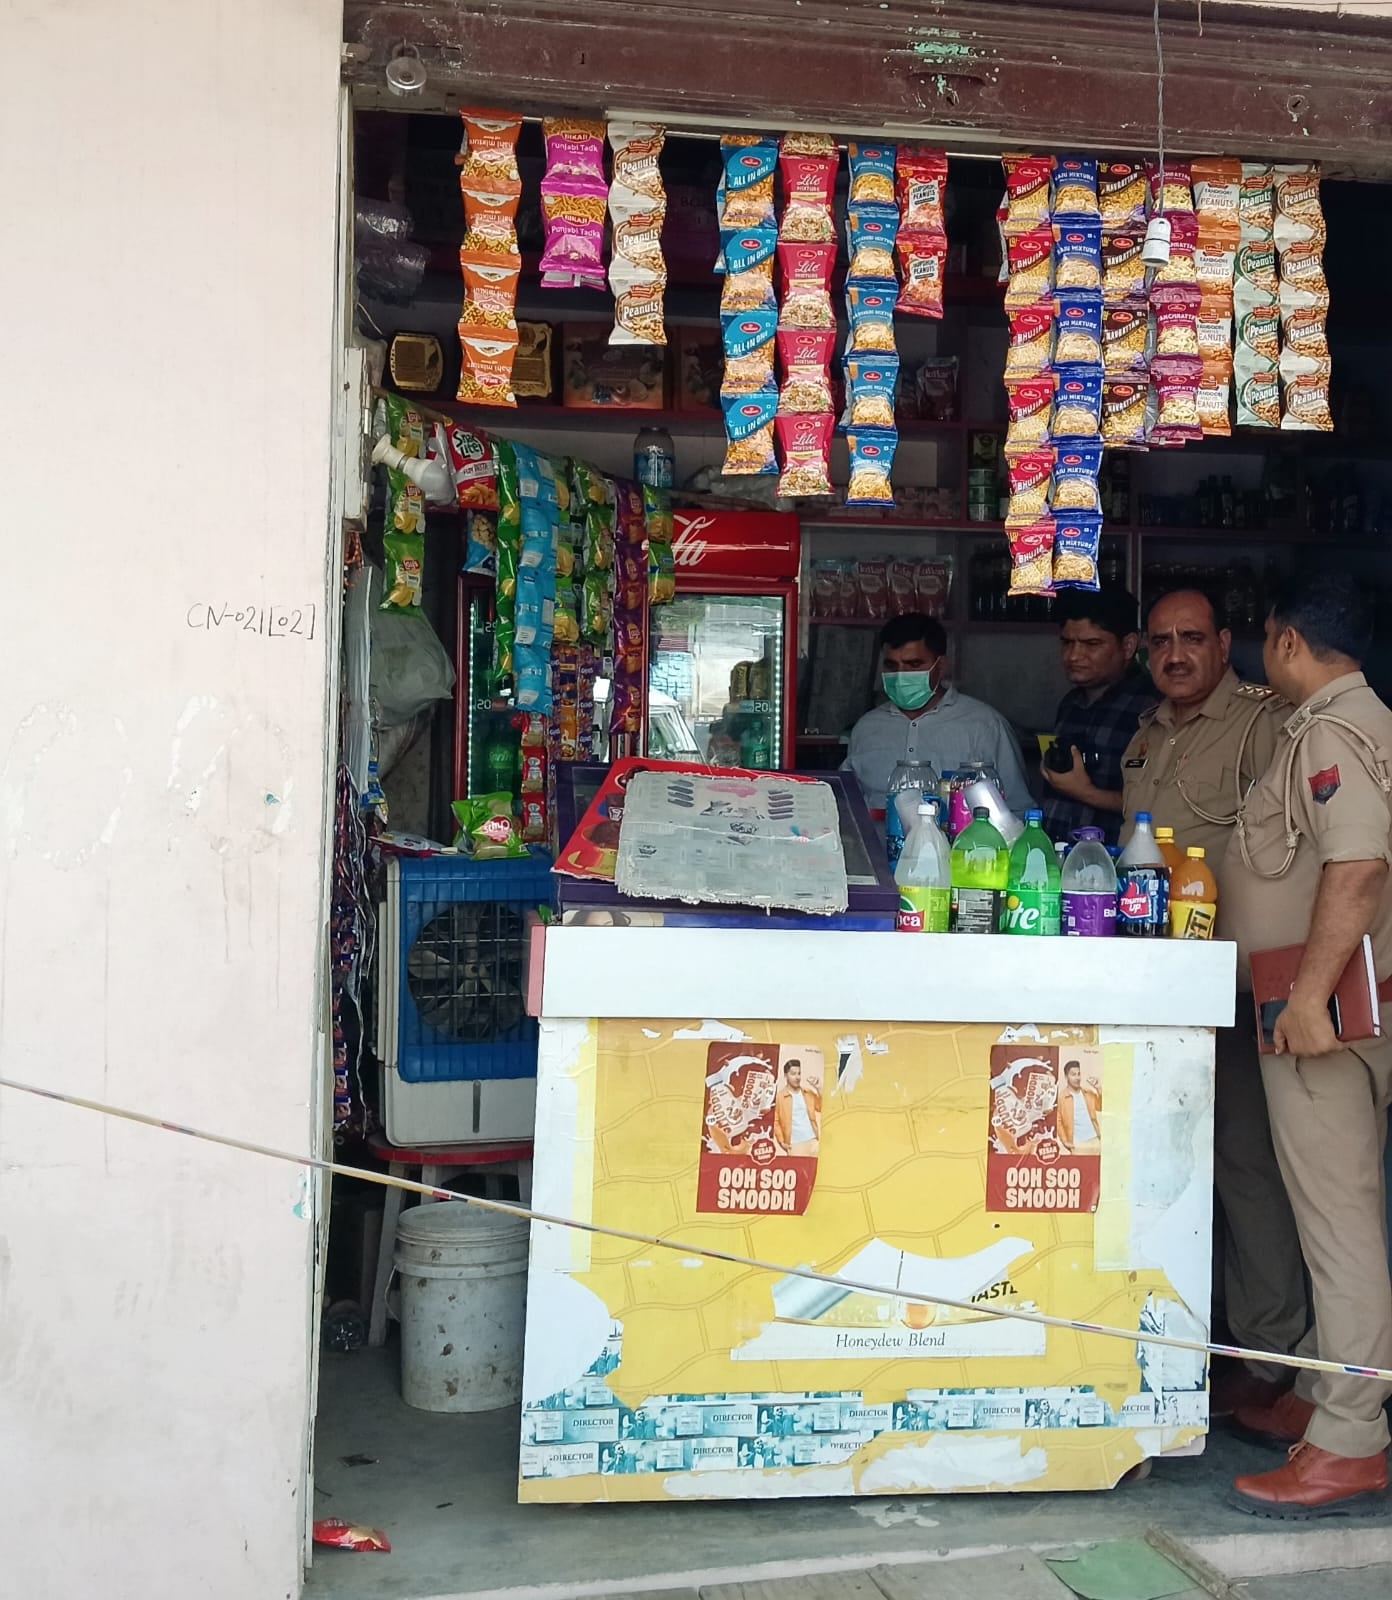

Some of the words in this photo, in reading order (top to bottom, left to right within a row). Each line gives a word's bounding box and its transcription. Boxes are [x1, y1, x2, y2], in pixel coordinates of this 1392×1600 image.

[621, 154, 657, 176] Peanuts
[734, 175, 746, 187] ALL
[747, 171, 756, 183] IN
[1016, 176, 1043, 195] BHUJIA
[1200, 197, 1234, 207] PEANUTS
[1240, 191, 1271, 210] Peanuts
[1284, 188, 1316, 208] Peanuts
[623, 228, 659, 248] Peanuts
[733, 258, 745, 269] ALL
[747, 254, 756, 266] IN
[1017, 250, 1044, 268] BHUJIA
[1286, 255, 1319, 275] Peanuts
[1196, 266, 1230, 276] PEANUTS
[623, 301, 659, 319] Peanuts
[1017, 324, 1044, 343] BHUJIA
[1199, 333, 1226, 342] EANUTS
[1290, 321, 1322, 341] Peanuts
[733, 342, 745, 353] ALL
[746, 339, 756, 350] IN
[1197, 400, 1225, 409] EANUTS
[1293, 388, 1325, 407] Peanuts
[1017, 398, 1044, 417] BHUJIA
[734, 425, 746, 436] ALL
[747, 420, 756, 432] IN
[1017, 471, 1044, 491] BHUJIA
[1018, 544, 1044, 564] BHUJIA
[1120, 896, 1147, 906] Thums
[719, 1167, 757, 1189] OOH
[759, 1168, 797, 1190] SOO
[1006, 1167, 1043, 1188] OOH
[1045, 1167, 1081, 1189] SOO
[717, 1188, 796, 1211] SMOODH
[1005, 1187, 1080, 1208] SMOODH
[836, 1333, 904, 1351] Honeydew
[908, 1332, 945, 1347] Blend
[712, 1413, 753, 1422] DIRECTOR
[849, 1409, 888, 1418] DIRECTOR
[983, 1406, 1022, 1416] DIRECTOR
[573, 1418, 614, 1427] DIRECTOR
[693, 1446, 733, 1455] DIRECTOR
[830, 1442, 864, 1450] DIRECTO
[553, 1453, 594, 1462] DIRECTOR
